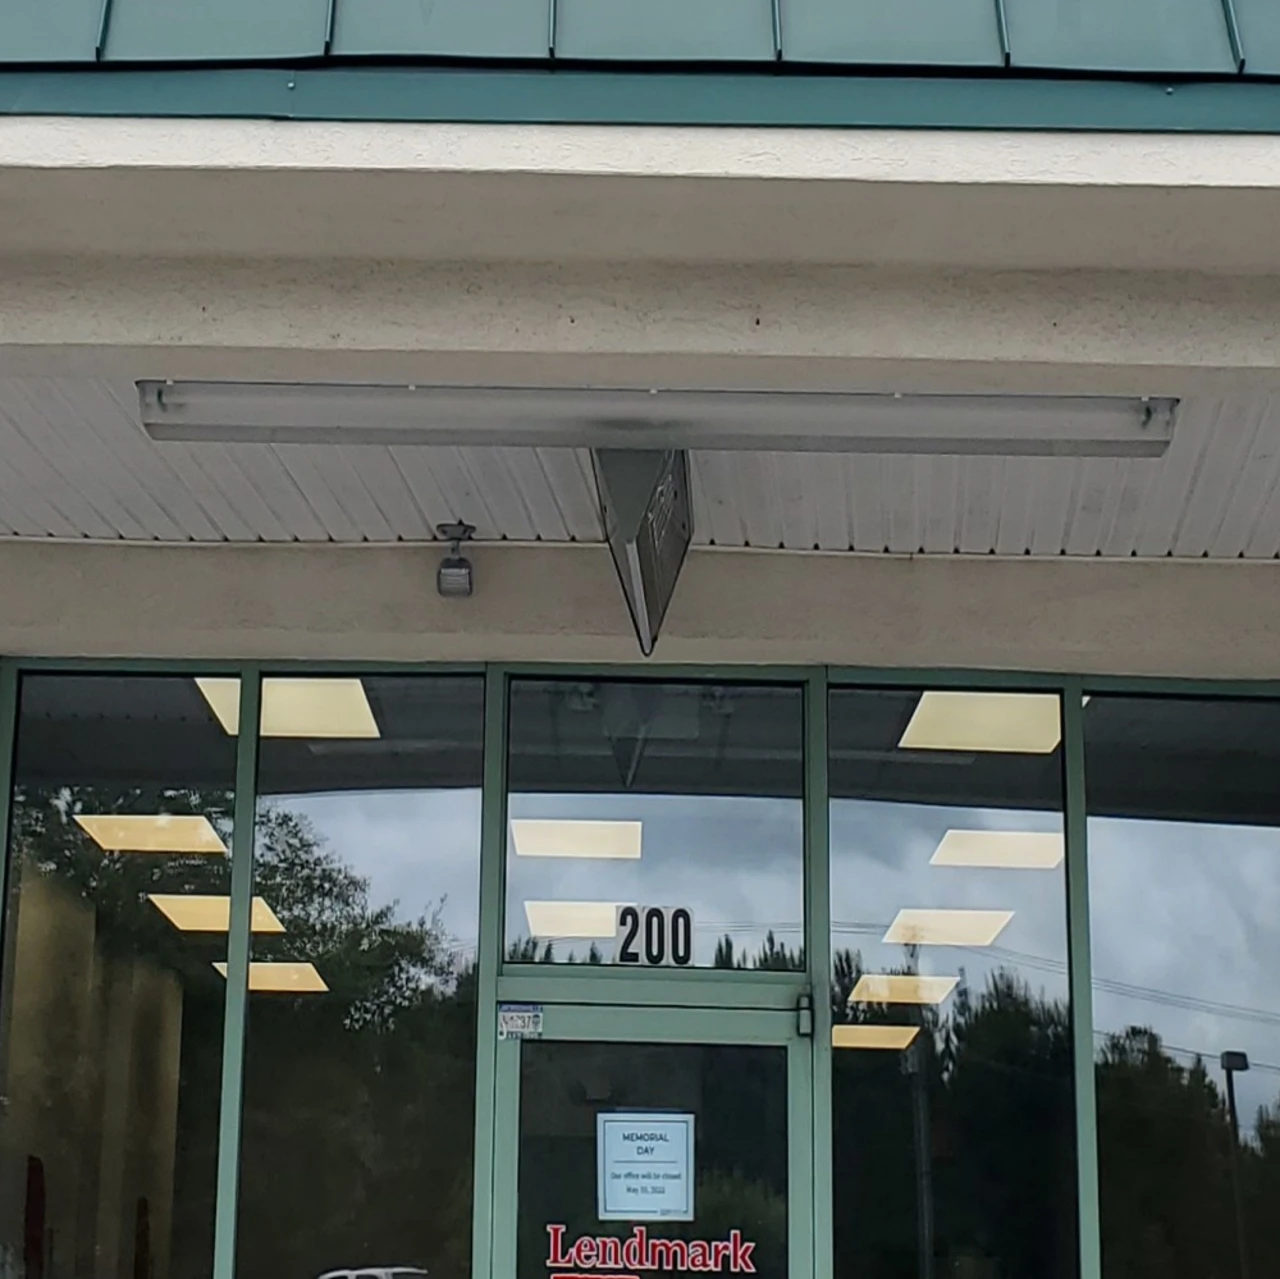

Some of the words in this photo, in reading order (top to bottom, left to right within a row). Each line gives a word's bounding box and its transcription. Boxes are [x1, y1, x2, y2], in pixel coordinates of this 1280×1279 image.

[619, 906, 691, 965] 200
[622, 1132, 669, 1142] MEMORIAL
[636, 1145, 655, 1156] DAY
[546, 1224, 756, 1272] Lendmark
